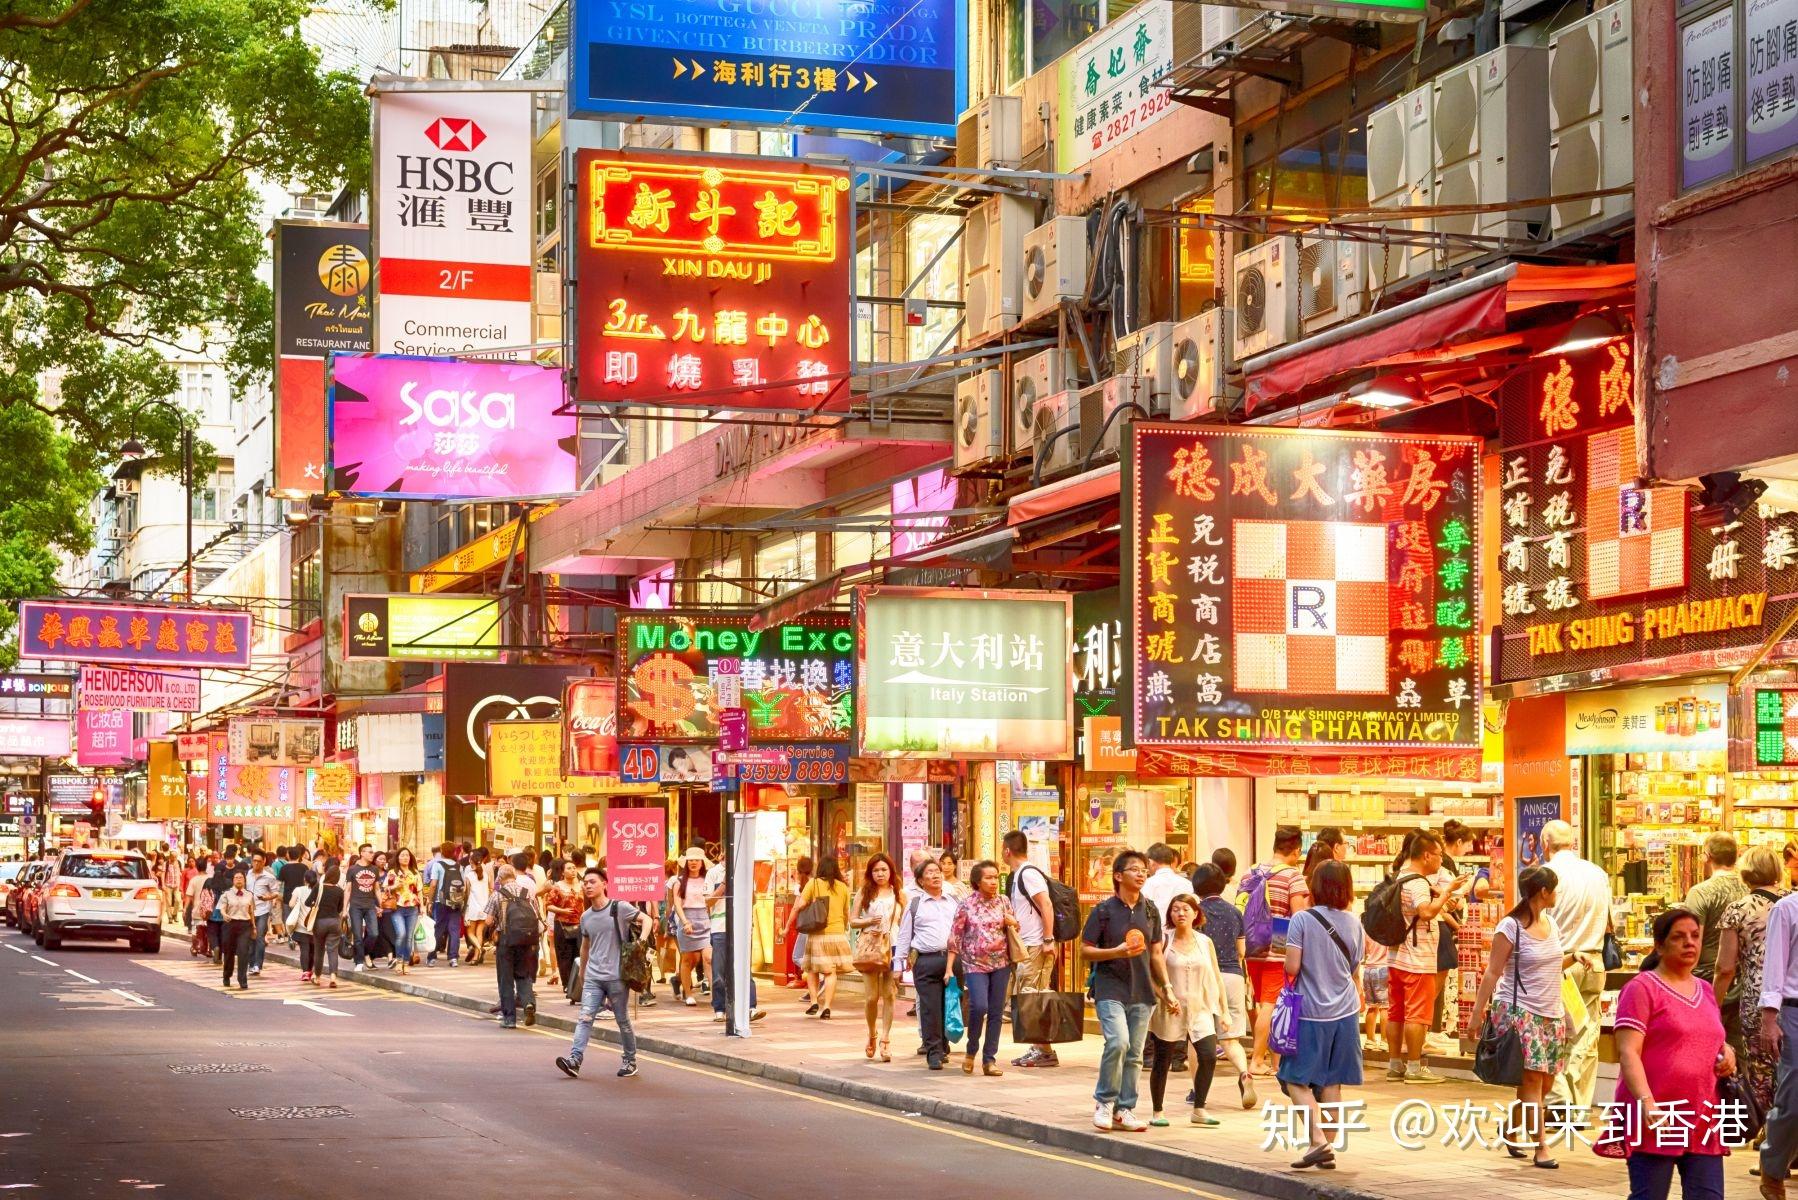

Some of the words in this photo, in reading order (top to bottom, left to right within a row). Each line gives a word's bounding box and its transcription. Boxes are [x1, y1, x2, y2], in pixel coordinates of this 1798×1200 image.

[610, 2, 665, 23] YSL
[674, 11, 758, 30] BOTTEGA
[763, 18, 830, 35] VENETA
[838, 19, 937, 44] PRADA
[606, 26, 733, 49] GIVENCHY
[742, 36, 861, 58] BURBERRY
[864, 42, 938, 65] DIOR
[713, 59, 838, 93] 海利行3樓
[1686, 50, 1732, 108] 防腳痛
[1106, 109, 1137, 142] 2827
[396, 155, 514, 196] HSBC
[627, 182, 801, 239] 新斗記
[439, 269, 474, 291] 2/F
[662, 257, 703, 277] XIN
[706, 259, 753, 280] DAU
[753, 262, 772, 285] JI
[604, 298, 649, 331] 3/F
[404, 319, 508, 341] Commercial
[672, 307, 830, 349] 九龍中心
[296, 337, 352, 350] RESTAURANT
[399, 381, 516, 429] Sasa
[405, 463, 441, 477] making
[442, 462, 463, 476] life
[463, 463, 508, 480] beautiful
[1165, 441, 1449, 512] 德成大藥房
[1145, 512, 1184, 664] 正貨商號
[1526, 621, 1564, 657] TAK
[1569, 611, 1635, 652] SHING
[1644, 591, 1769, 641] PHARMACY
[636, 624, 761, 657] Money
[889, 630, 1044, 672] 意大利站
[28, 683, 70, 693] BONJOUR
[85, 669, 164, 693] HENDERSON
[84, 694, 126, 707] ROSEWOOD
[126, 696, 165, 709] FURNITURE
[166, 698, 172, 709] &
[173, 698, 196, 710] CHEST
[930, 687, 965, 704] Italy
[971, 687, 1029, 703] Station
[1261, 708, 1282, 720] O/B
[1283, 709, 1306, 721] TAK
[1413, 712, 1460, 723] LIMITED
[91, 731, 118, 749] 超市
[1156, 716, 1209, 739] TAK
[1216, 717, 1302, 741] SHING
[1311, 719, 1461, 742] PHARMACY
[623, 748, 659, 781] 4D
[787, 745, 836, 759] Service
[741, 761, 793, 781] 3599
[795, 761, 847, 781] 8899
[1512, 759, 1562, 778] mannings
[51, 777, 88, 785] BESPOKE
[90, 777, 124, 786] TALORS
[162, 784, 186, 796] 名人
[510, 779, 561, 790] Welcome
[1523, 802, 1559, 816] ANNECY
[612, 820, 659, 840] Sasa
